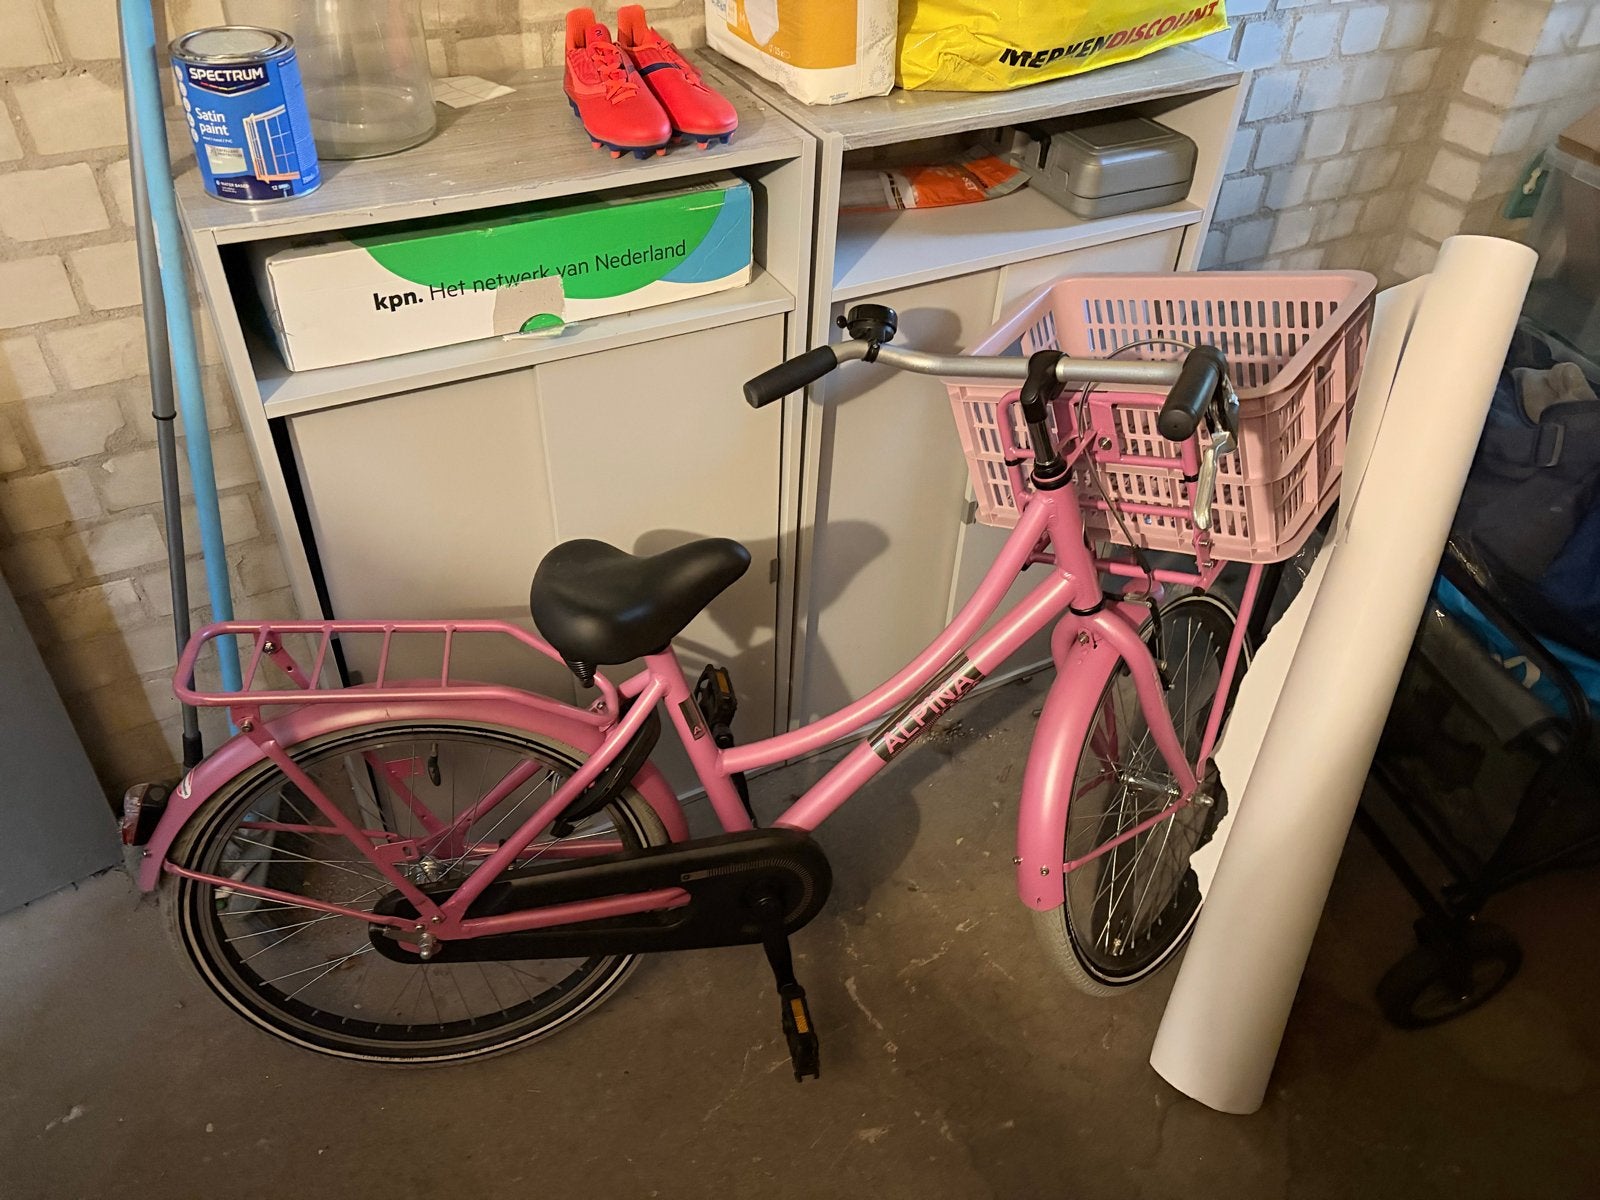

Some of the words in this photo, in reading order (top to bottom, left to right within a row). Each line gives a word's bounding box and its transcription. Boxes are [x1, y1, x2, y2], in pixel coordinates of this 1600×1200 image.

[189, 67, 264, 82] SPECTRUM
[195, 107, 226, 123] Satin
[199, 122, 230, 136] paint
[373, 289, 424, 312] kpn.
[429, 279, 466, 301] Het
[473, 264, 550, 293] netwerk
[556, 261, 589, 278] van
[595, 239, 687, 272] Nederland
[883, 672, 976, 754] ALPINA
